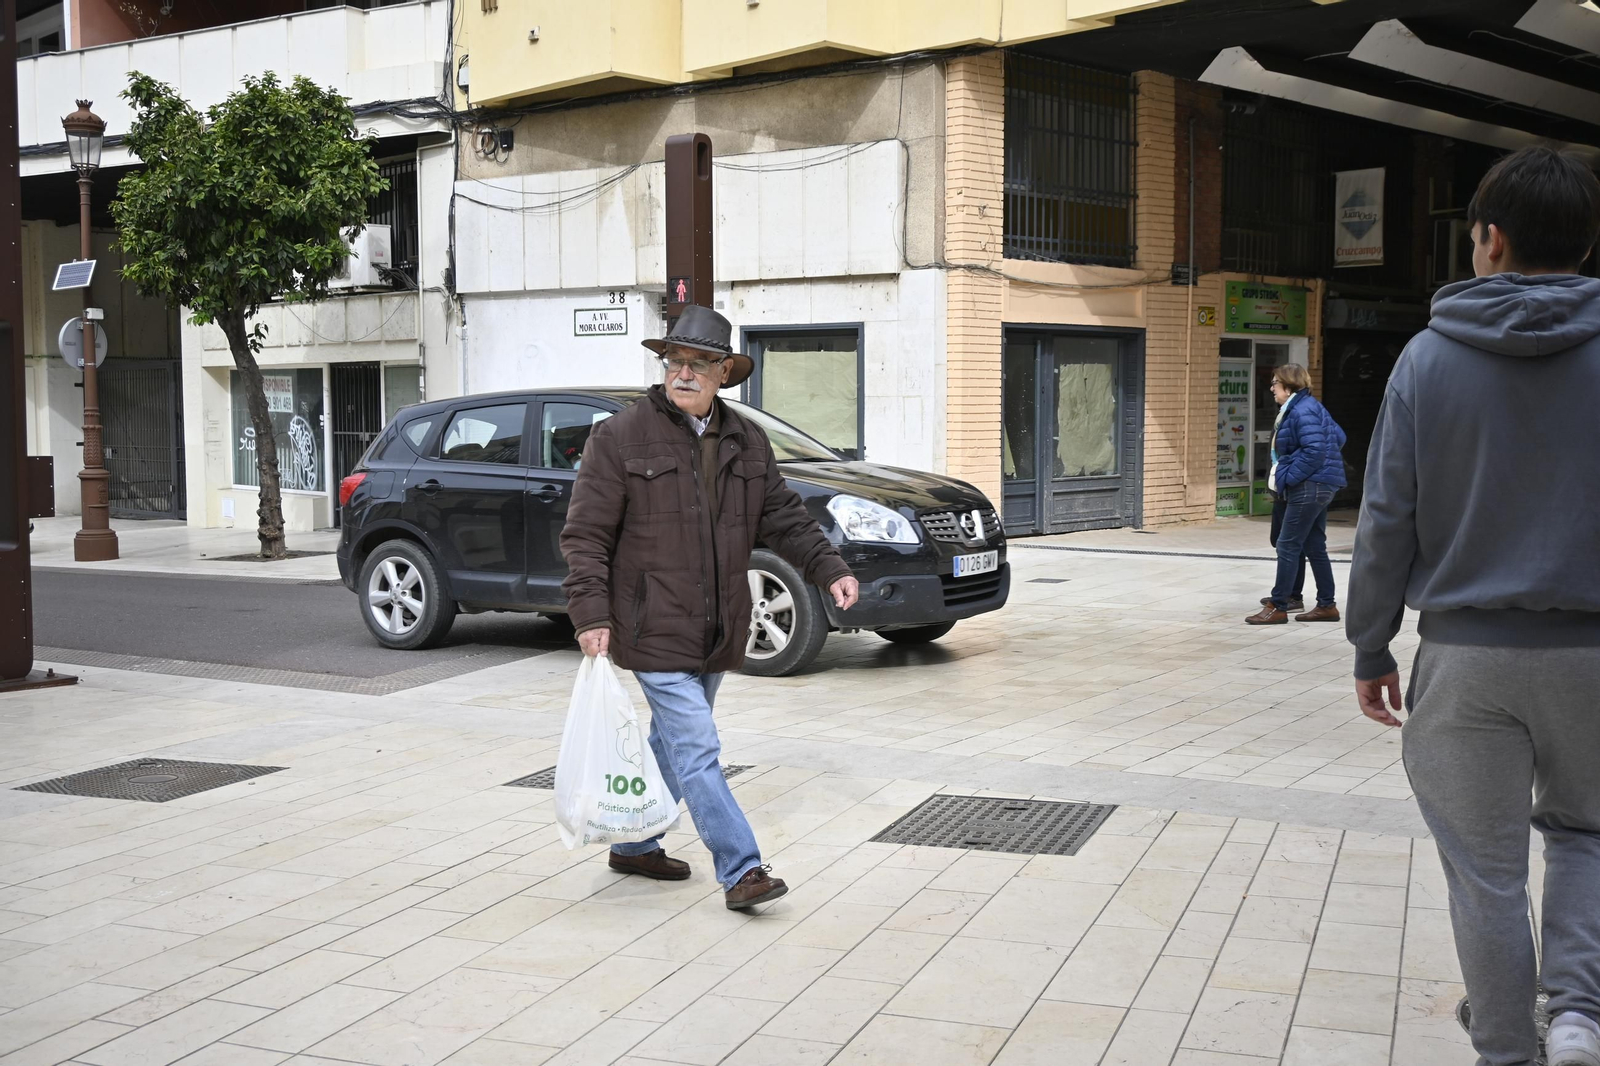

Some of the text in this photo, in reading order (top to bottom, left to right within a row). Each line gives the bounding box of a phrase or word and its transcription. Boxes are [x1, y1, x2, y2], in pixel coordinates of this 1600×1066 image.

[1336, 246, 1382, 257] Cruzcampo
[609, 291, 625, 304] 38
[1242, 288, 1279, 300] GRUPO STRONG
[579, 322, 623, 332] MORA CLAROS
[263, 378, 290, 393] ISPONIBLE
[1220, 379, 1248, 394] ctura
[960, 556, 981, 572] 0126
[587, 819, 616, 833] Reutiliza
